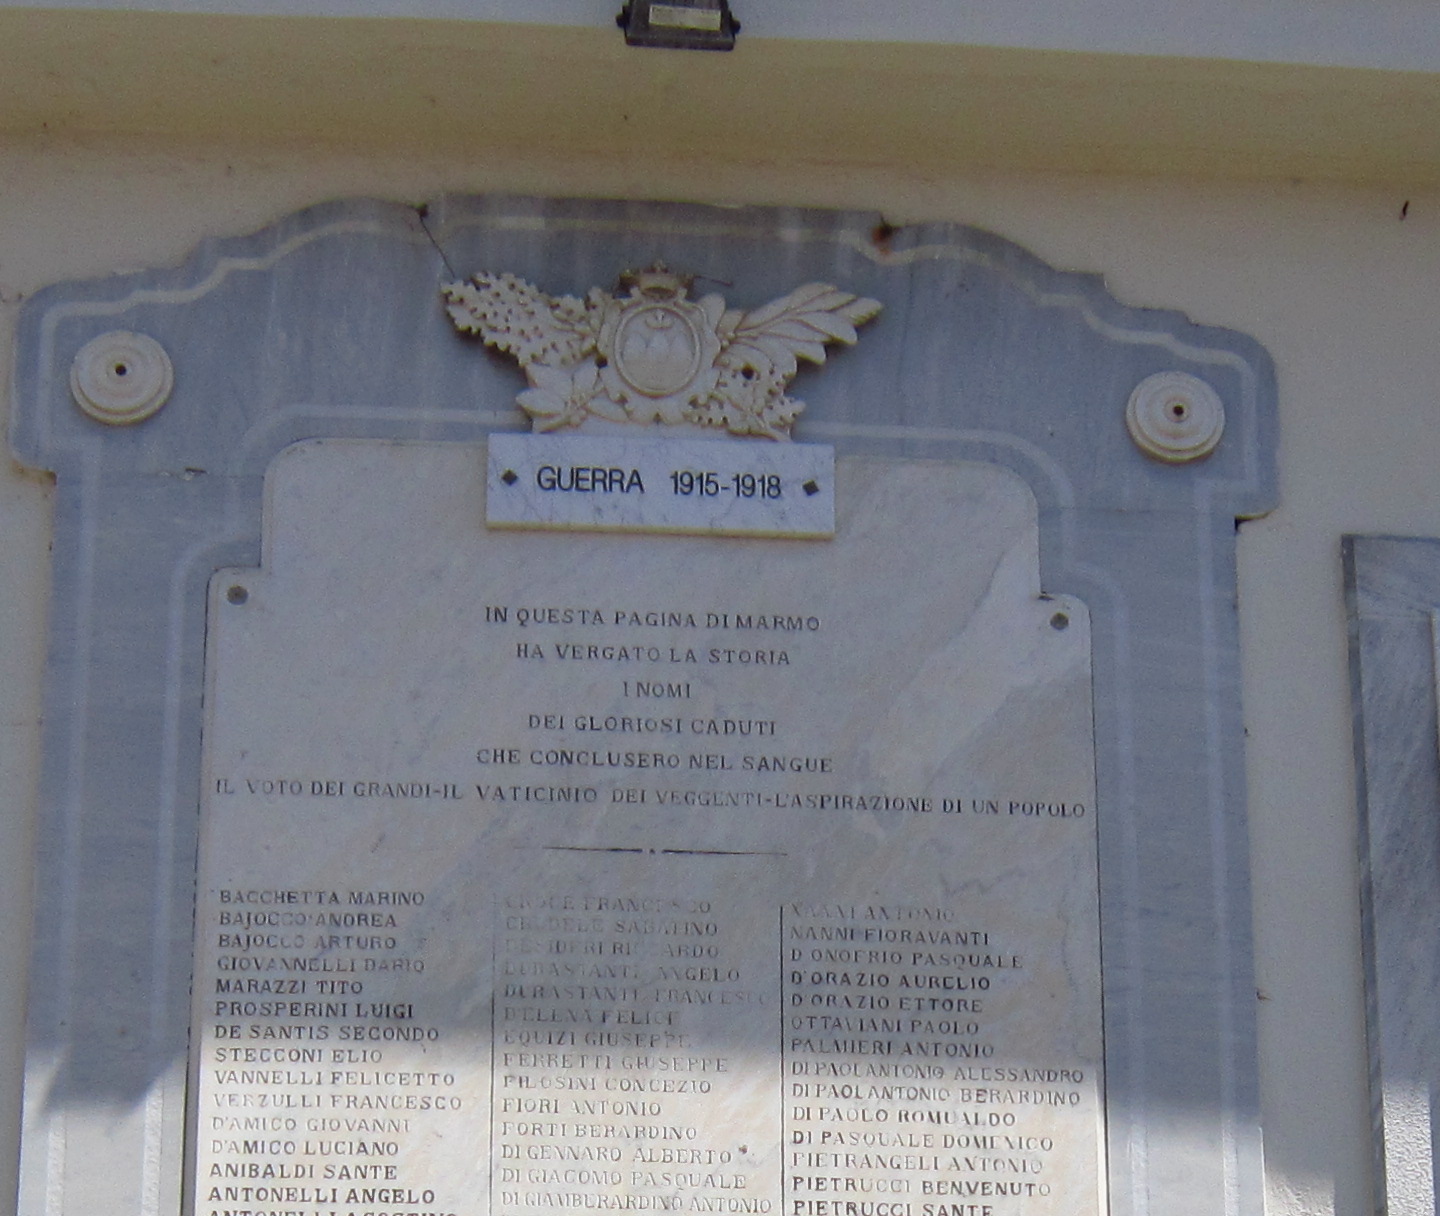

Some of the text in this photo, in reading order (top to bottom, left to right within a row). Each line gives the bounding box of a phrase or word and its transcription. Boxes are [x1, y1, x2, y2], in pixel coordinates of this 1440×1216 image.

[537, 465, 781, 498] GUERRA 1915-1918
[485, 607, 819, 630] IN QUESTA PAGINA DI MARMO
[517, 643, 790, 664] HA VERGATO LA STORIA
[624, 682, 691, 698] I NOMI
[528, 715, 775, 735] DEI GLORIOSI CADUTI
[477, 749, 832, 773] CHE CONCLUSERO NEL SANGUE
[216, 780, 234, 794] IL
[247, 780, 303, 795] VOTO
[311, 781, 344, 795] DEI
[476, 785, 596, 801] VATICINIO
[612, 789, 646, 802] DEI
[943, 799, 961, 813] DI
[972, 800, 998, 815] UN
[1009, 801, 1086, 817] POPOLO
[220, 890, 424, 906] BACCHETTA MARINO
[216, 979, 362, 994] MARAZZI TITO
[215, 1002, 414, 1019] PROSPERINI LUIGI
[215, 1026, 438, 1041] DE SANTIS SECONDO
[210, 1188, 434, 1204] ANTONELLI ANGELO
